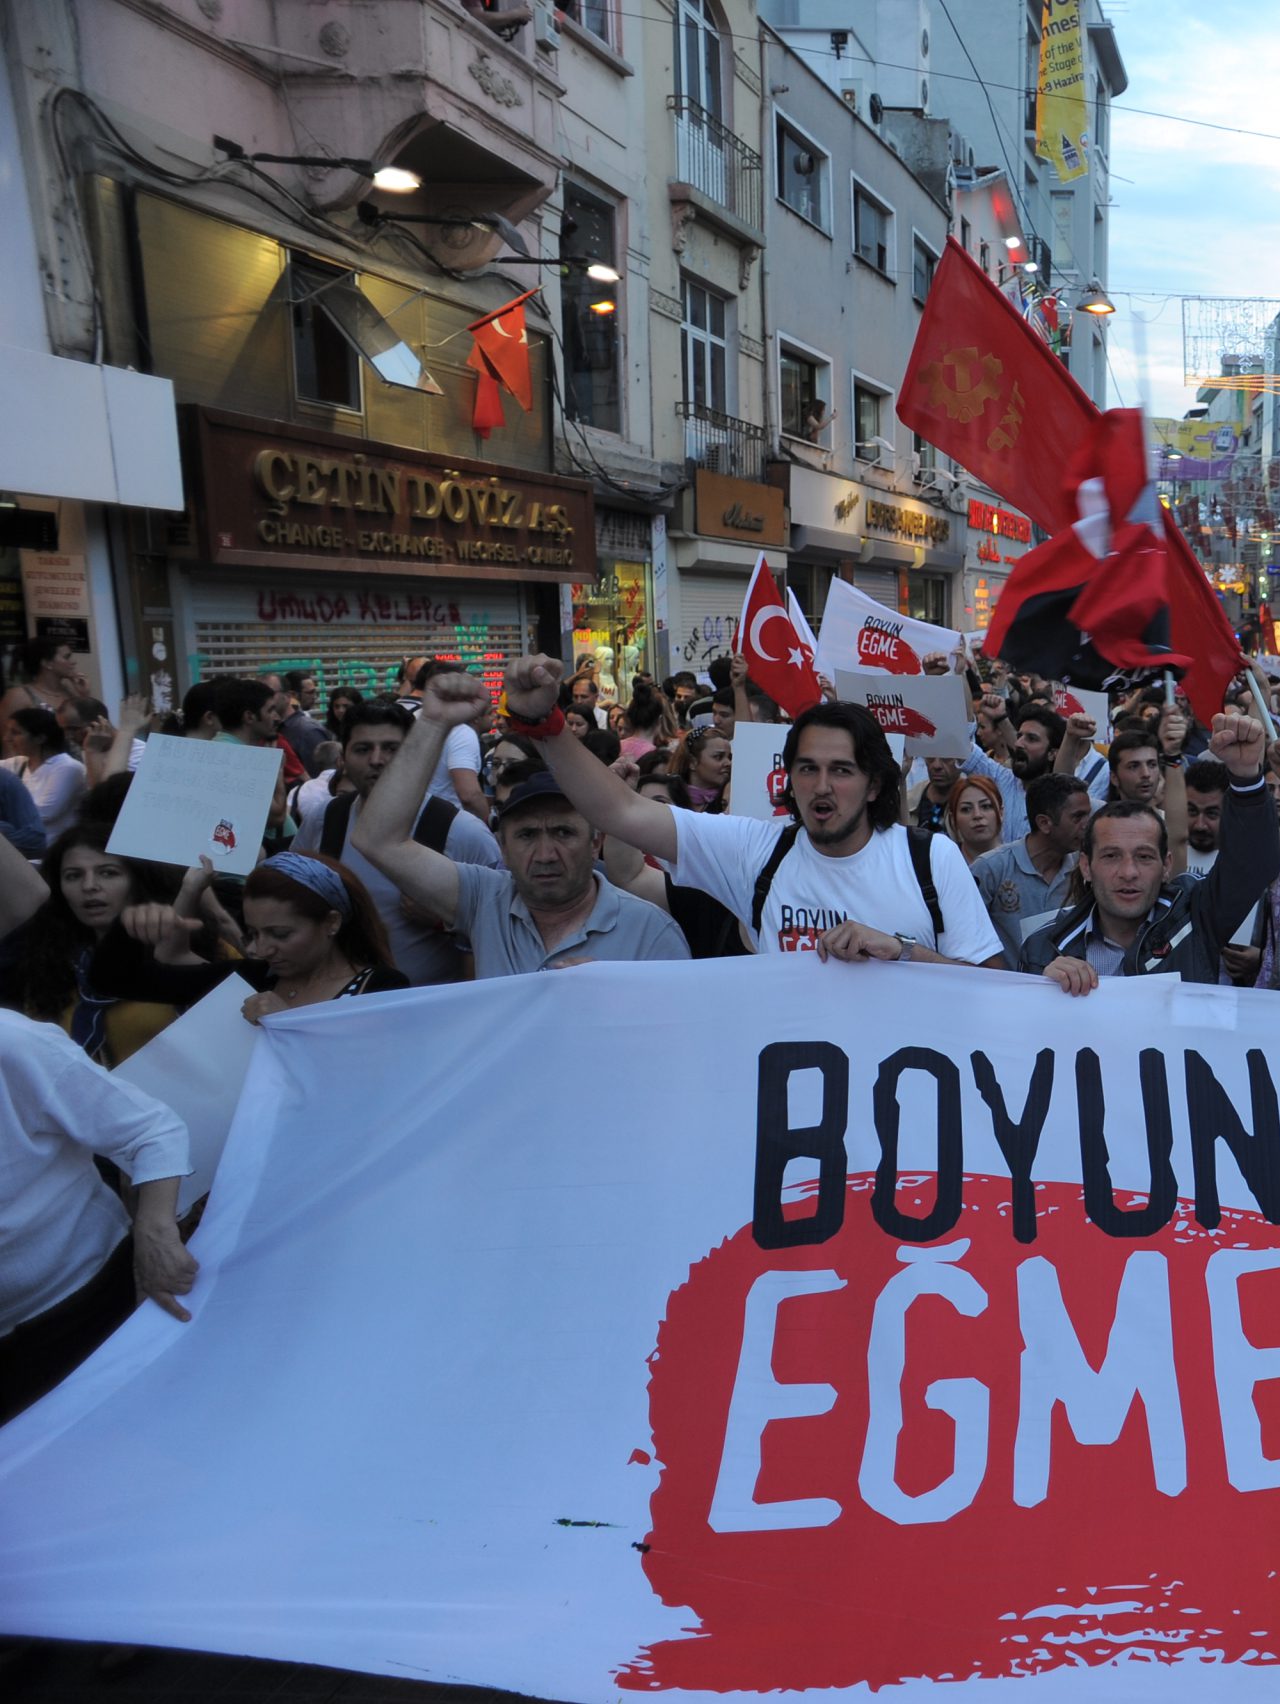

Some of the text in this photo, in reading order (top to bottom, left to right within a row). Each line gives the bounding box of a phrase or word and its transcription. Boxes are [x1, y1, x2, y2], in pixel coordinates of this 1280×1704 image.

[1049, 57, 1077, 72] Stage
[255, 449, 401, 516] ÇETİN
[411, 468, 525, 529] DÖVİZ
[258, 519, 343, 549] CHANGE
[360, 532, 446, 559] EXCHANGE
[457, 540, 520, 564] WECHSEL
[864, 615, 904, 639] BOYUN
[860, 632, 900, 660] EĞME
[866, 693, 904, 708] BOYUN
[781, 904, 848, 938] BOYUN
